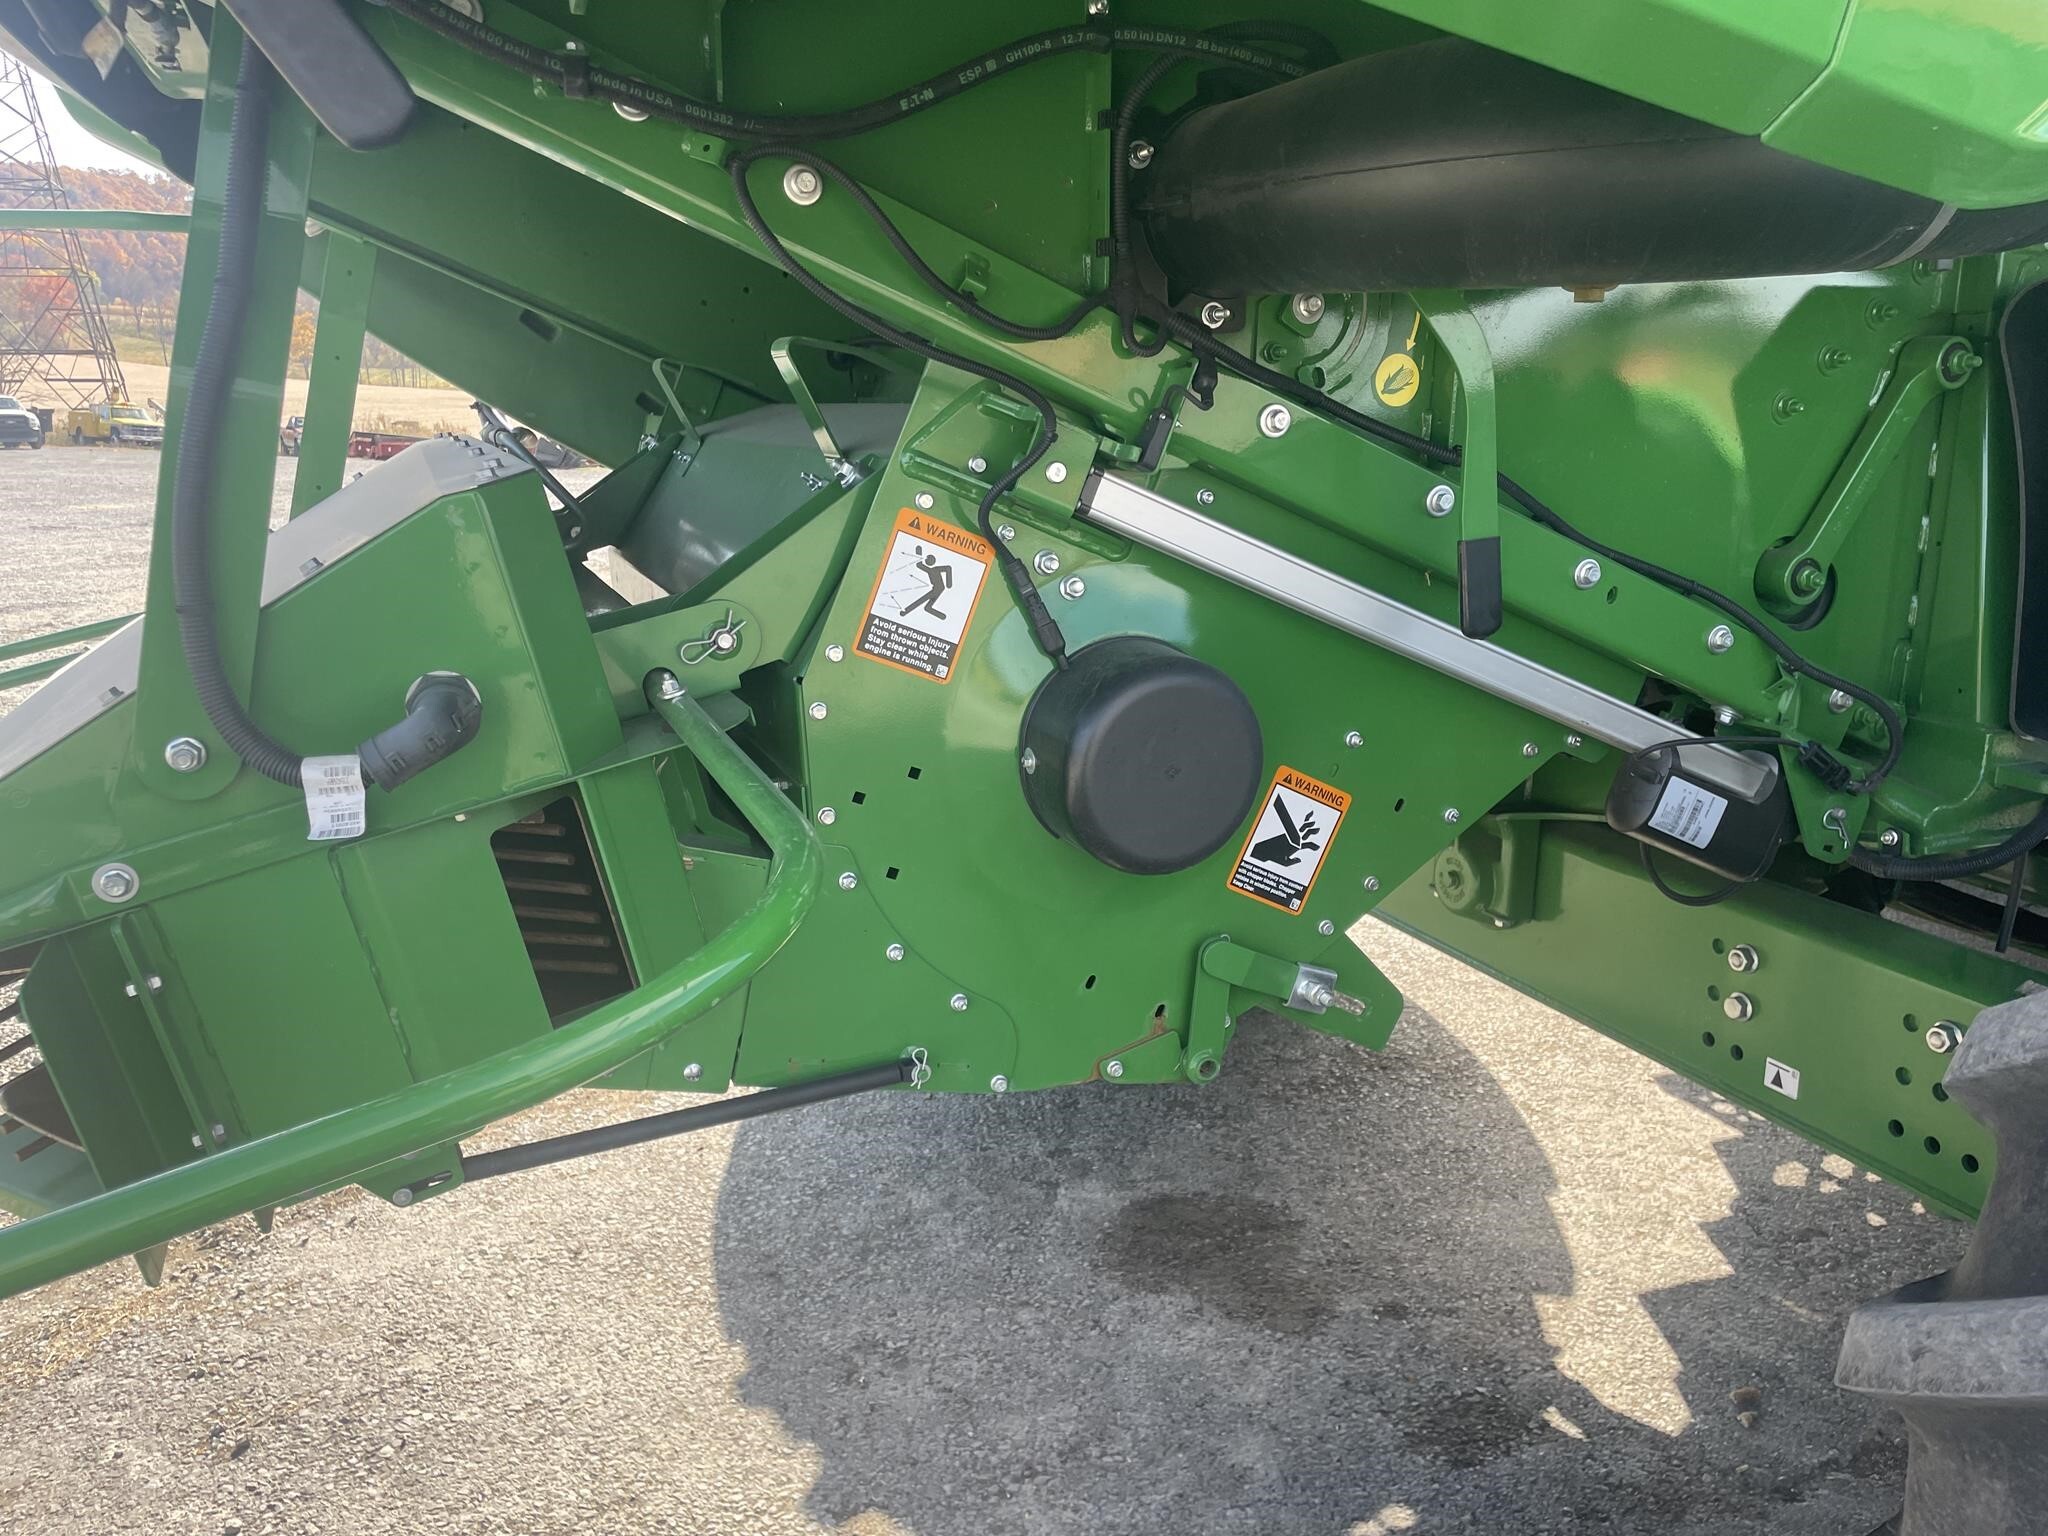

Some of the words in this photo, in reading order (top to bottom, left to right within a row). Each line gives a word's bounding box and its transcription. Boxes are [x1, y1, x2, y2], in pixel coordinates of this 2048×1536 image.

[589, 71, 627, 93] Made
[629, 86, 642, 97] in
[645, 91, 674, 108] USA
[685, 103, 735, 126] 0001382
[958, 65, 983, 85] ESP
[1005, 40, 1052, 63] GH100-8
[1062, 32, 1084, 45] 12.7
[1139, 30, 1155, 42] in)
[1156, 32, 1187, 46] DN12
[1195, 39, 1210, 51] 28
[1210, 42, 1229, 55] bar
[1229, 46, 1252, 61] (400
[1252, 55, 1273, 69] psi)
[926, 522, 987, 555] WARNING
[867, 633, 886, 647] Stay
[887, 641, 907, 653] clear
[908, 648, 929, 661] while
[870, 625, 889, 638] from
[891, 633, 917, 648] thrown
[919, 644, 949, 660] objects.
[872, 617, 897, 631] Avoid
[898, 627, 927, 642] serious
[928, 636, 951, 652] injury
[864, 642, 892, 657] engine
[893, 651, 901, 660] is
[902, 655, 934, 672] running.
[1295, 776, 1344, 807] WARNING
